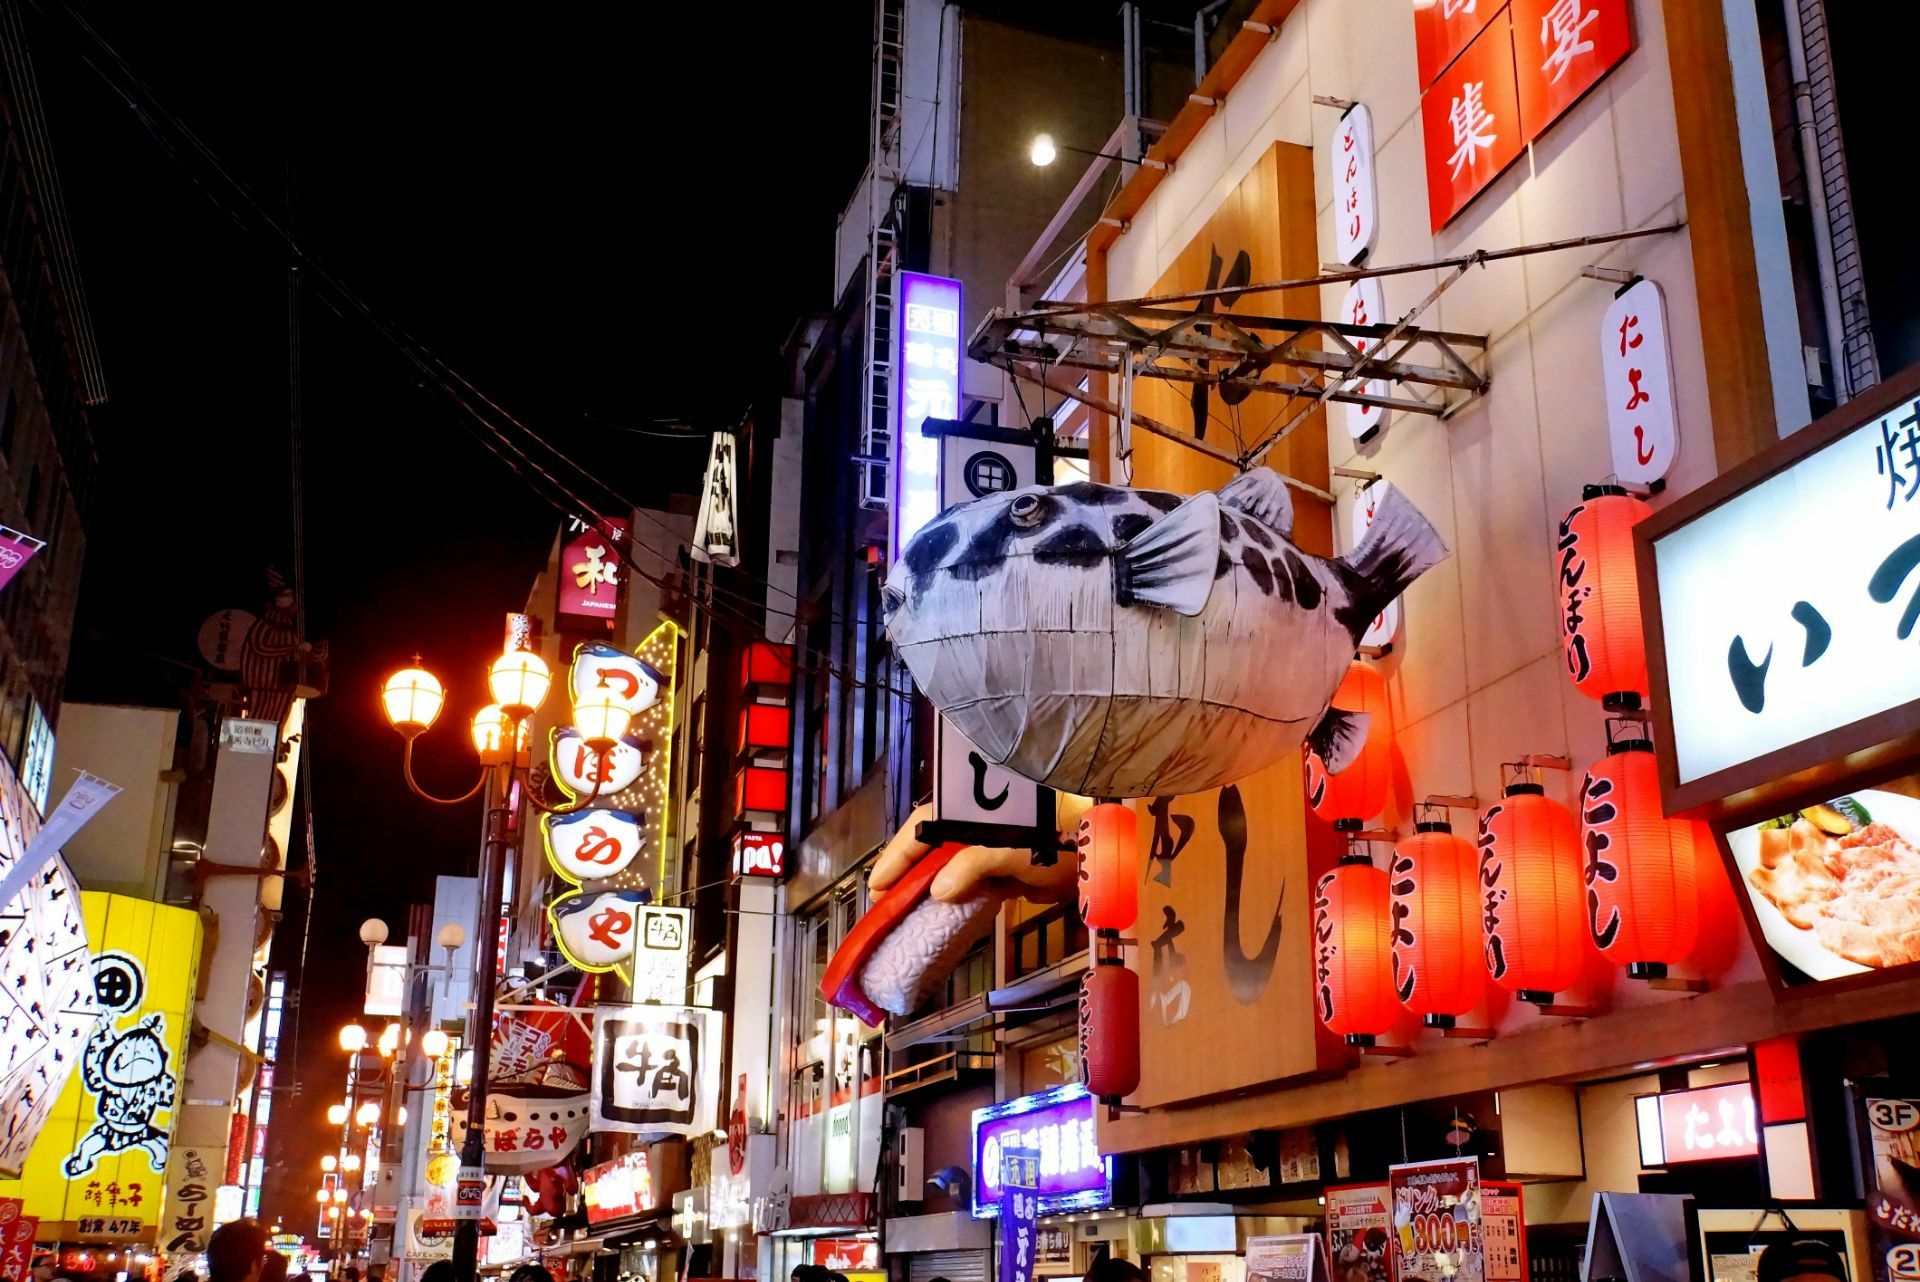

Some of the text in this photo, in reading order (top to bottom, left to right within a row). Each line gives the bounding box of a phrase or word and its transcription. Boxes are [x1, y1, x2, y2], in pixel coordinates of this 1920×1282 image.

[1618, 313, 1655, 466] たよし
[1558, 505, 1591, 683] とんぼり
[1477, 804, 1507, 981] とんぼり
[1580, 769, 1619, 951] たよし
[649, 919, 679, 943] 牛角
[1314, 873, 1339, 1024] とんぼり
[1388, 848, 1416, 1004] たよし
[615, 1038, 690, 1101] 牛角
[483, 1126, 568, 1153] ぼらや
[1875, 1104, 1912, 1125] 3F
[84, 1181, 143, 1208] 薩摩っ子
[166, 1184, 208, 1252] らーめん
[1894, 1249, 1920, 1272] 2
